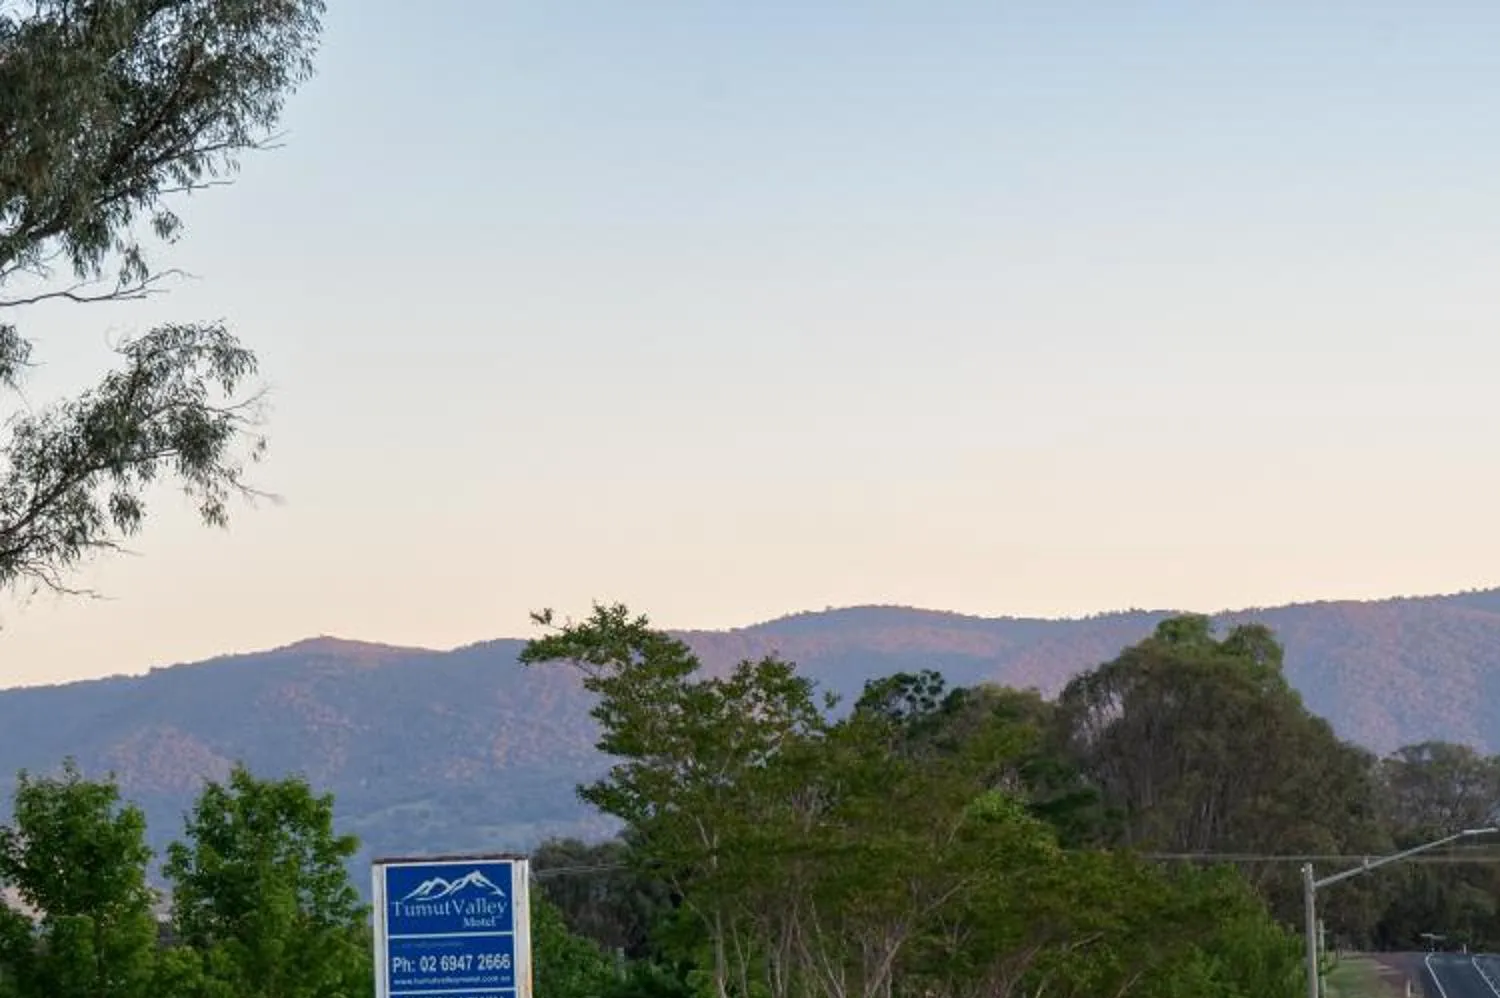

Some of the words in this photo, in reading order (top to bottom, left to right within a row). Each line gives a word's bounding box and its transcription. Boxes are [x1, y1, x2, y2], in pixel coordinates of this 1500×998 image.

[392, 957, 416, 973] Ph:
[419, 956, 437, 972] 02
[441, 955, 473, 971] 6947
[477, 953, 511, 971] 2666
